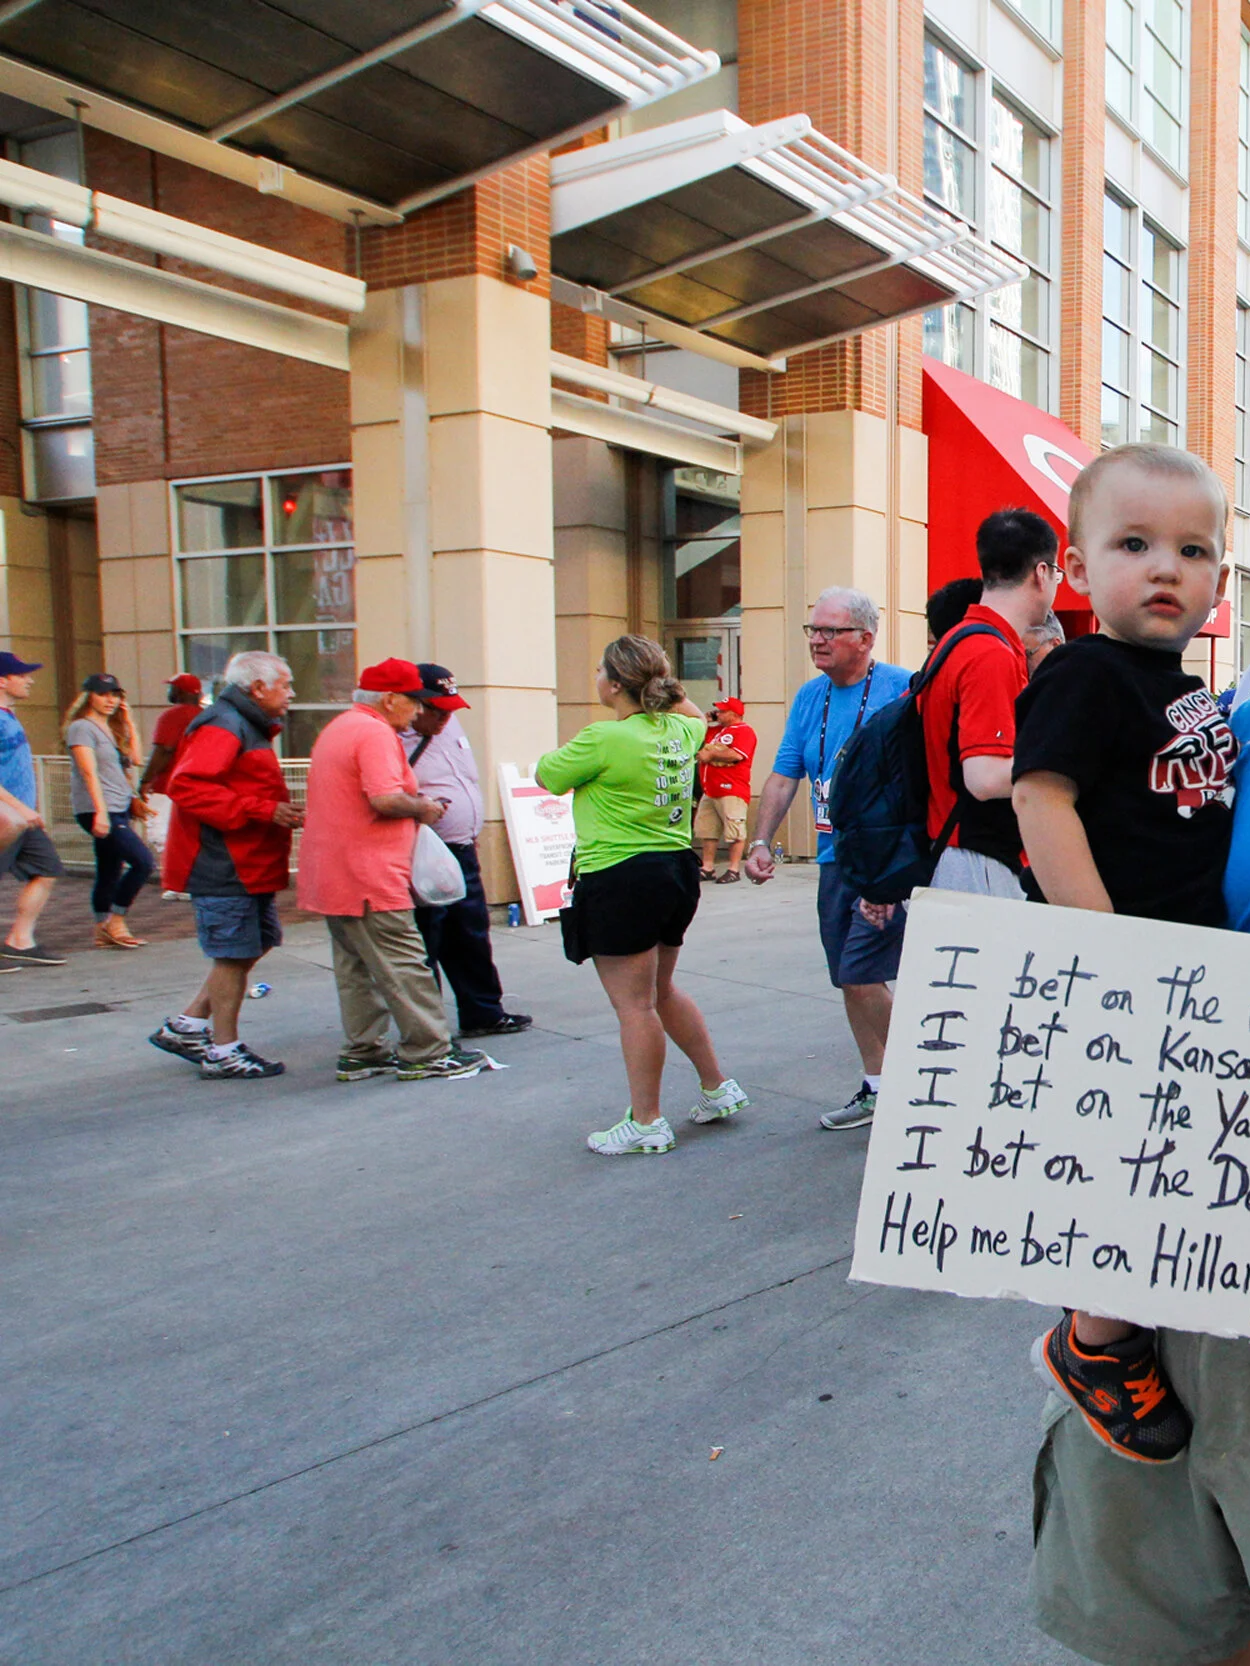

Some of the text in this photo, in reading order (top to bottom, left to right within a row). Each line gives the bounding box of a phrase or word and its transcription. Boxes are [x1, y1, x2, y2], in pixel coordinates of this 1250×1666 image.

[929, 946, 979, 989] I
[1010, 951, 1097, 1007] bet
[1102, 991, 1133, 1014] on
[1157, 965, 1222, 1023] the
[917, 1011, 967, 1051] I
[997, 1004, 1068, 1060] bet
[1086, 1034, 1132, 1064] on
[909, 1067, 957, 1107] I
[988, 1063, 1052, 1111] bet
[1076, 1089, 1112, 1119] on
[1140, 1080, 1192, 1133] the
[897, 1126, 941, 1171] I
[963, 1126, 1039, 1179] bet
[1044, 1155, 1094, 1185] on
[1120, 1138, 1193, 1197] the
[880, 1192, 957, 1272] Help
[971, 1226, 1010, 1256] me
[1021, 1211, 1088, 1267] bet
[1093, 1245, 1132, 1273] on
